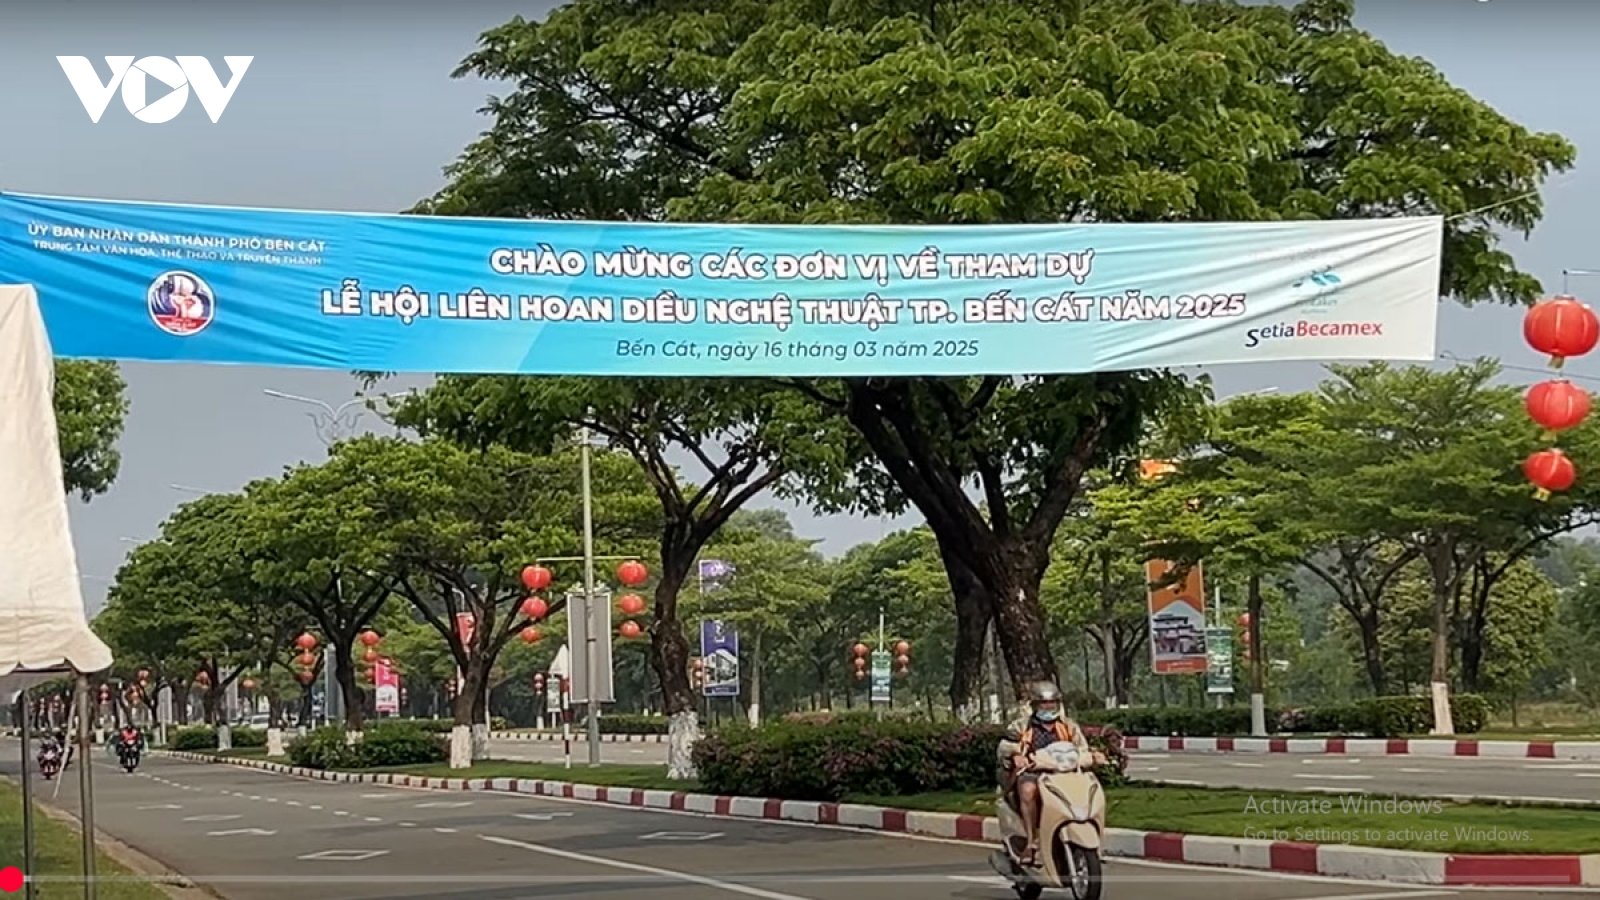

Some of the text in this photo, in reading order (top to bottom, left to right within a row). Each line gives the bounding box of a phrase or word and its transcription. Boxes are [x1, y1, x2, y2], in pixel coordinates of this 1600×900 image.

[33, 240, 73, 252] TRUNG
[52, 226, 85, 239] BAN
[298, 239, 326, 252] CÁT
[489, 243, 1095, 287] CHÀO MỪNG CÁC ĐƠN VỊ VỀ THAM DỰ
[320, 278, 1247, 331] LỄ HỘI LIÊN HOAN DIỀU NGHỆ THUẬT TP. BẾN CÁT NĂM 2025
[1244, 319, 1383, 348] SetiaBecamex
[616, 338, 980, 363] Bến Cát, ngày 16 tháng 03 năm 2025
